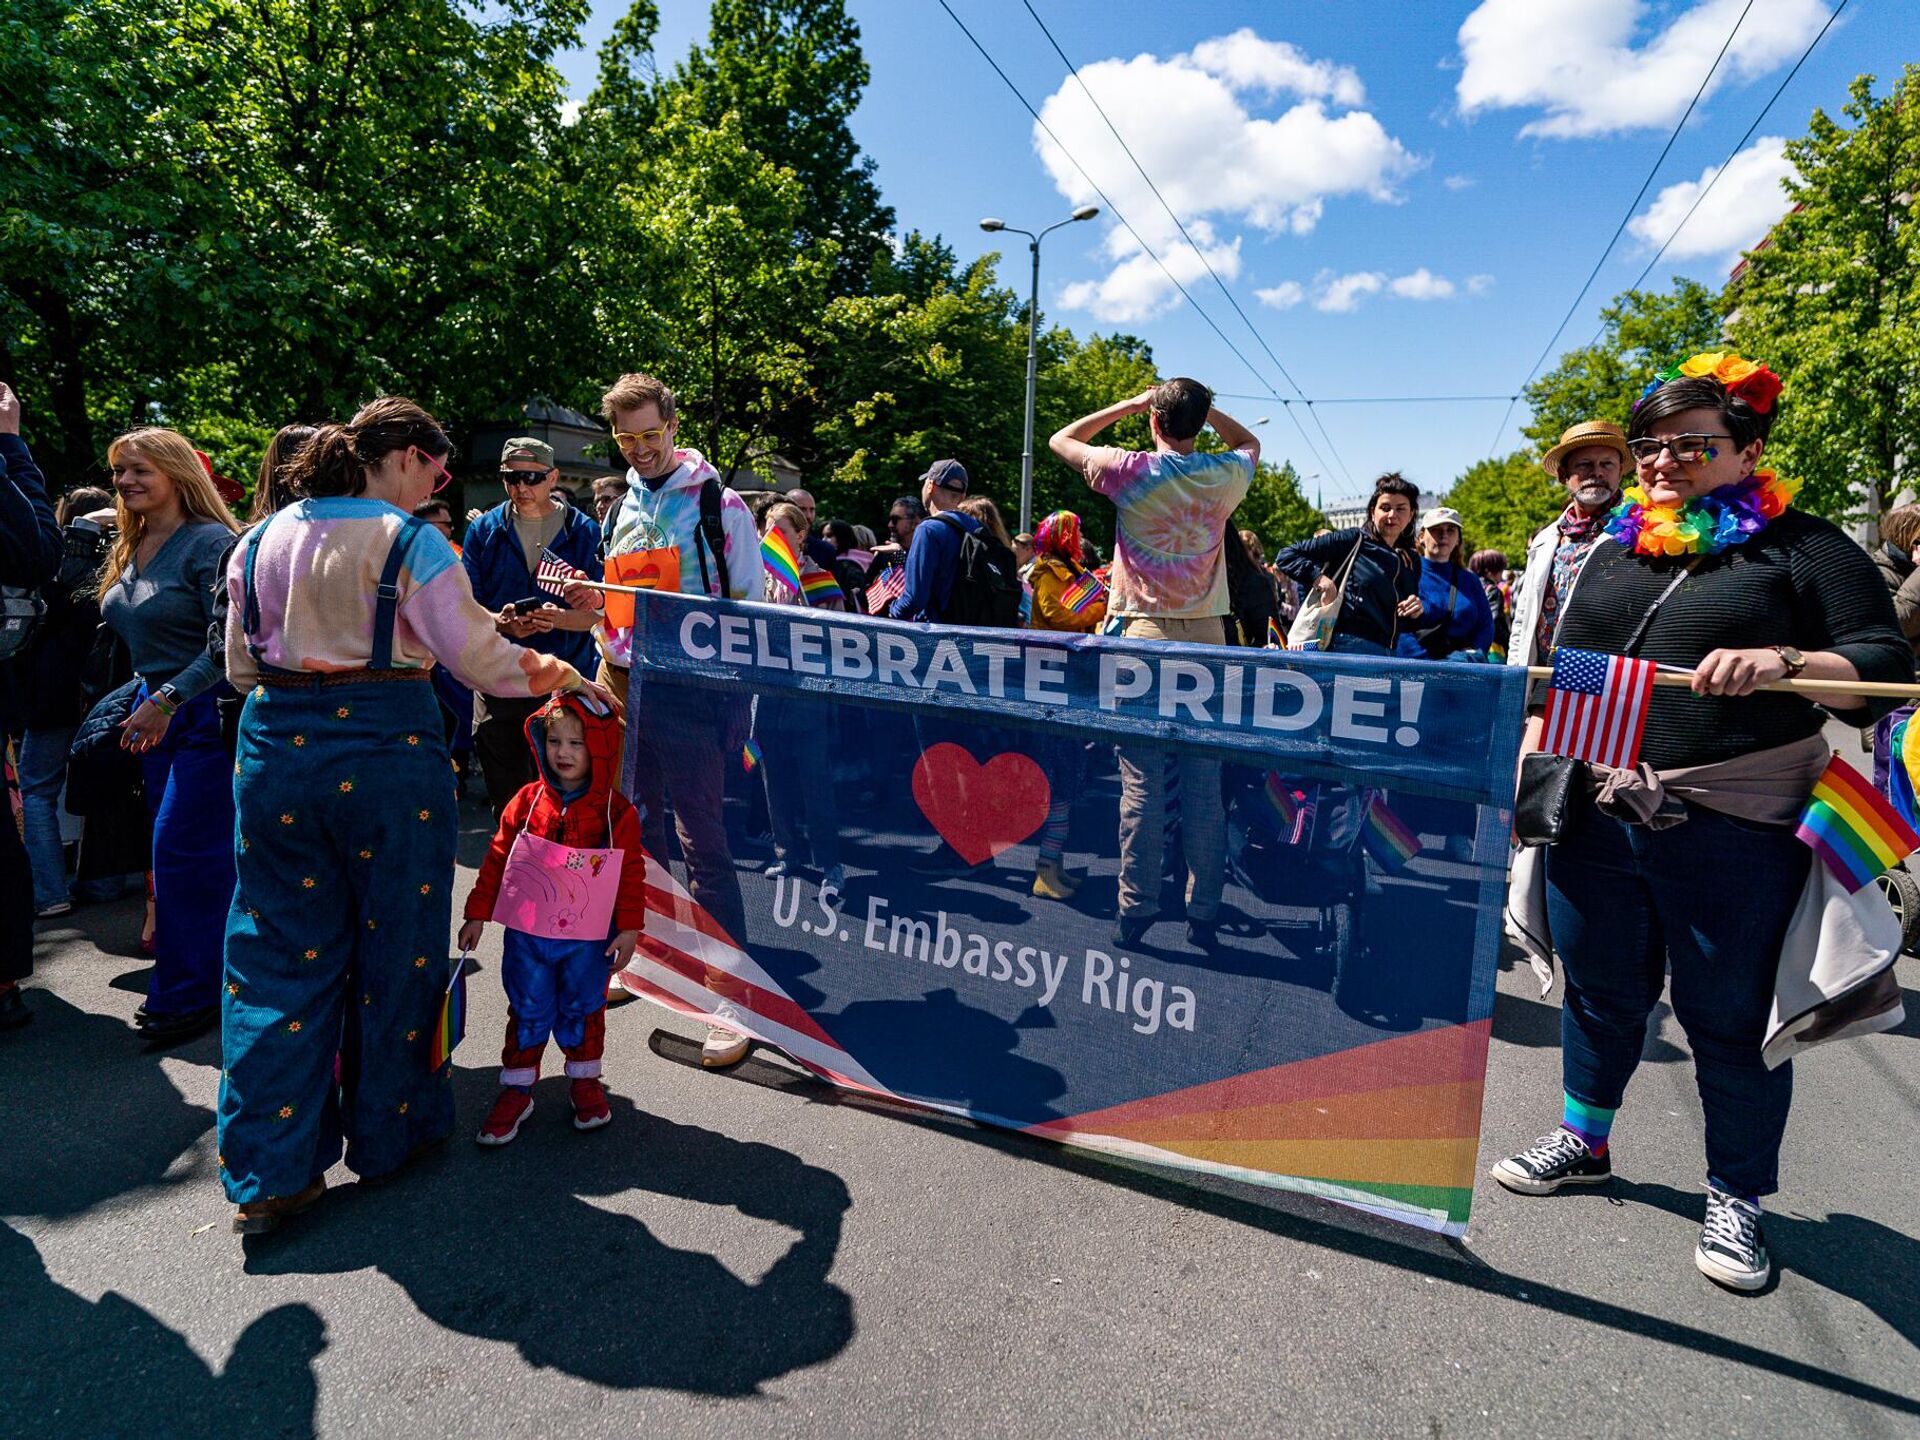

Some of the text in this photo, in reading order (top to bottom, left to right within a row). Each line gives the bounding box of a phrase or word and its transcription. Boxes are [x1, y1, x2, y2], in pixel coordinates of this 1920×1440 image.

[680, 611, 1425, 747] CELEBRATE PRIDE!
[772, 875, 1198, 1035] U.S. Embassy Riga
